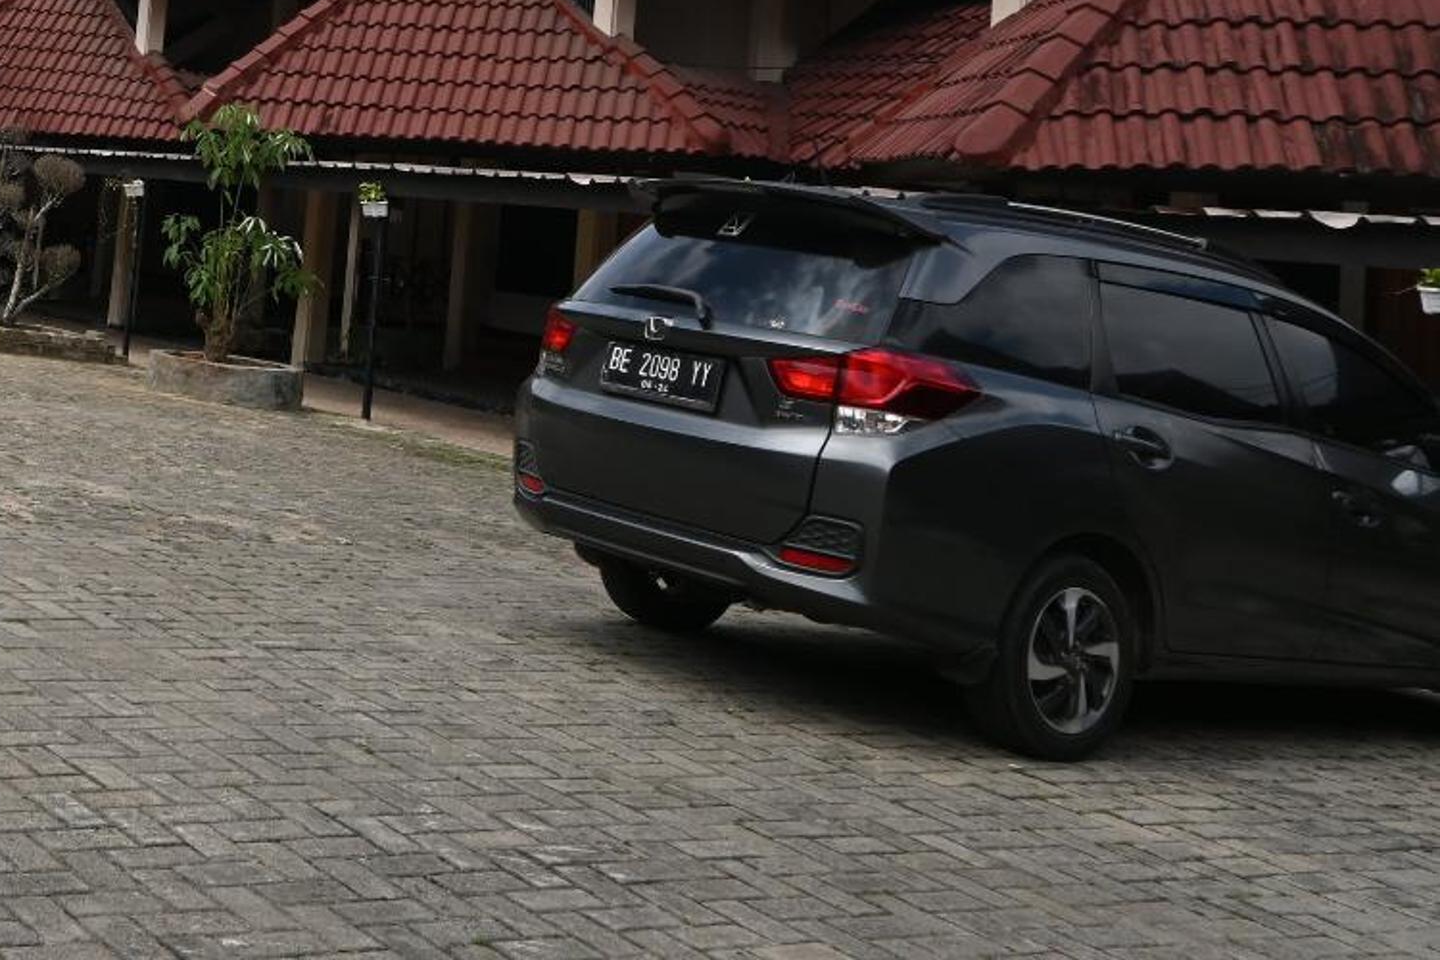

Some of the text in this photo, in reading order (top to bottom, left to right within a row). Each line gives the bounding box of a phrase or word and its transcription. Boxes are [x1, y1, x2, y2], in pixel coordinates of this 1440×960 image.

[609, 346, 712, 387] BE 2098 YY
